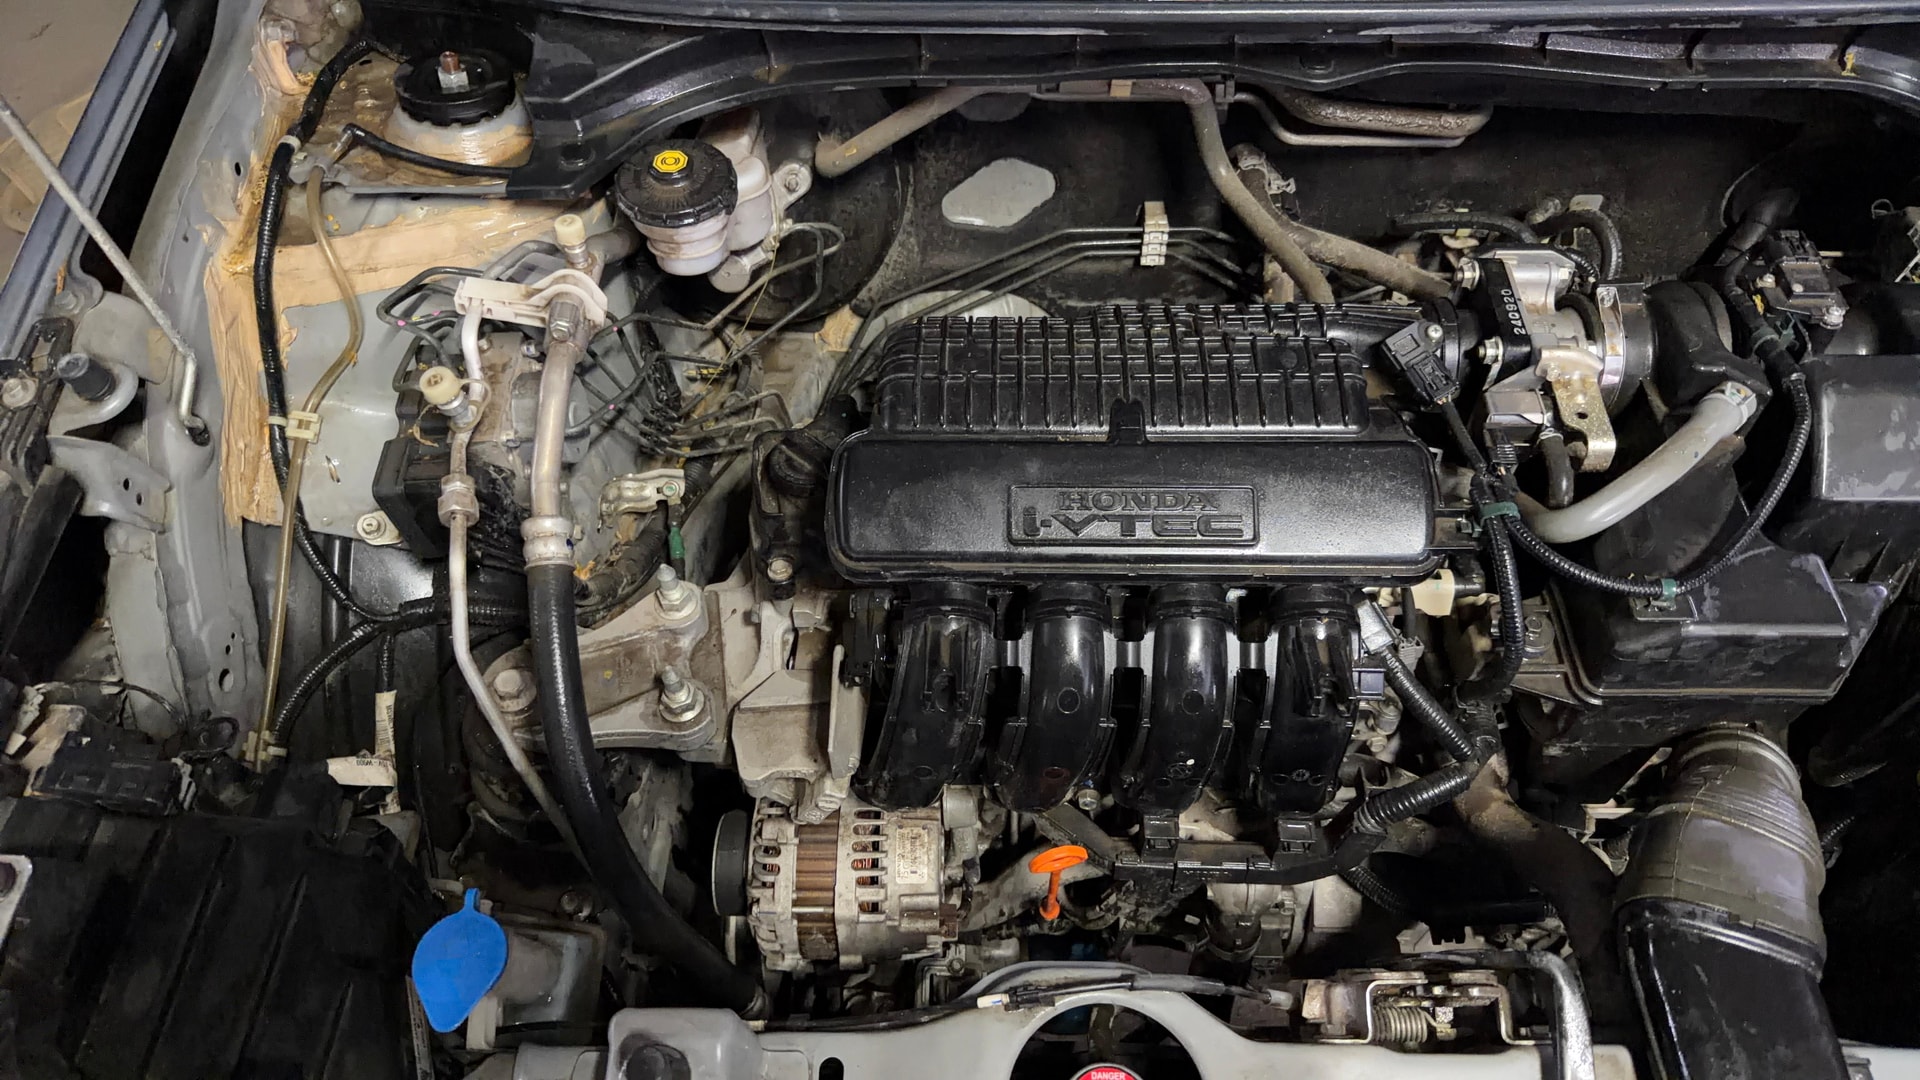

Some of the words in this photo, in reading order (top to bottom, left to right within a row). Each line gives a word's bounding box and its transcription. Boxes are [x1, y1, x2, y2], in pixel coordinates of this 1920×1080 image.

[1500, 288, 1527, 336] 240920
[1059, 491, 1219, 512] HONDA
[1022, 506, 1245, 538] i-VTEC
[1091, 1071, 1126, 1080] DANGER
